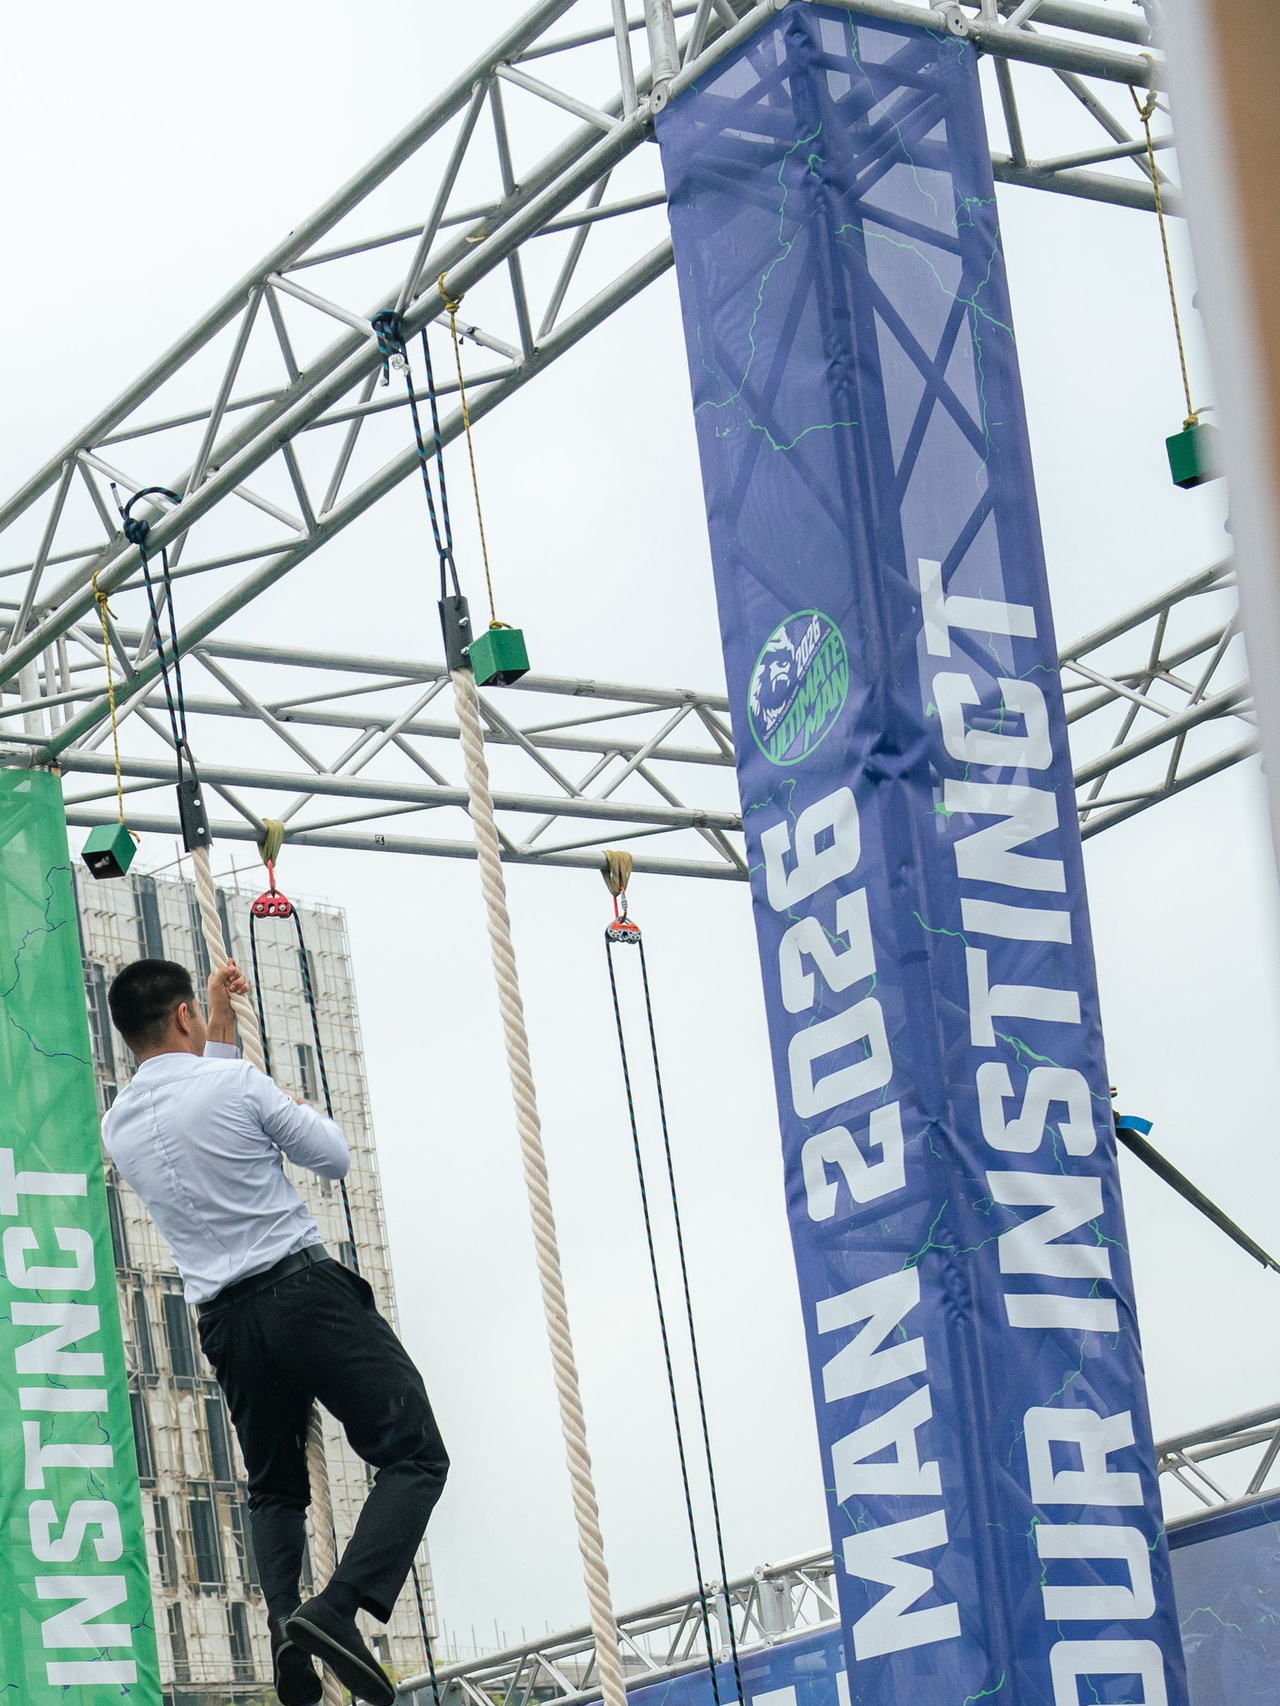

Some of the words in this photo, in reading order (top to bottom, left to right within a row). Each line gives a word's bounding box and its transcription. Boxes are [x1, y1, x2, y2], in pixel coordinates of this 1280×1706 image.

[770, 634, 845, 760] ULTIMATE
[796, 615, 820, 678] 2026
[804, 664, 847, 753] MAN
[761, 786, 906, 1222] 2026
[918, 556, 1119, 1332] INSTINCT
[816, 1267, 961, 1661] MAN
